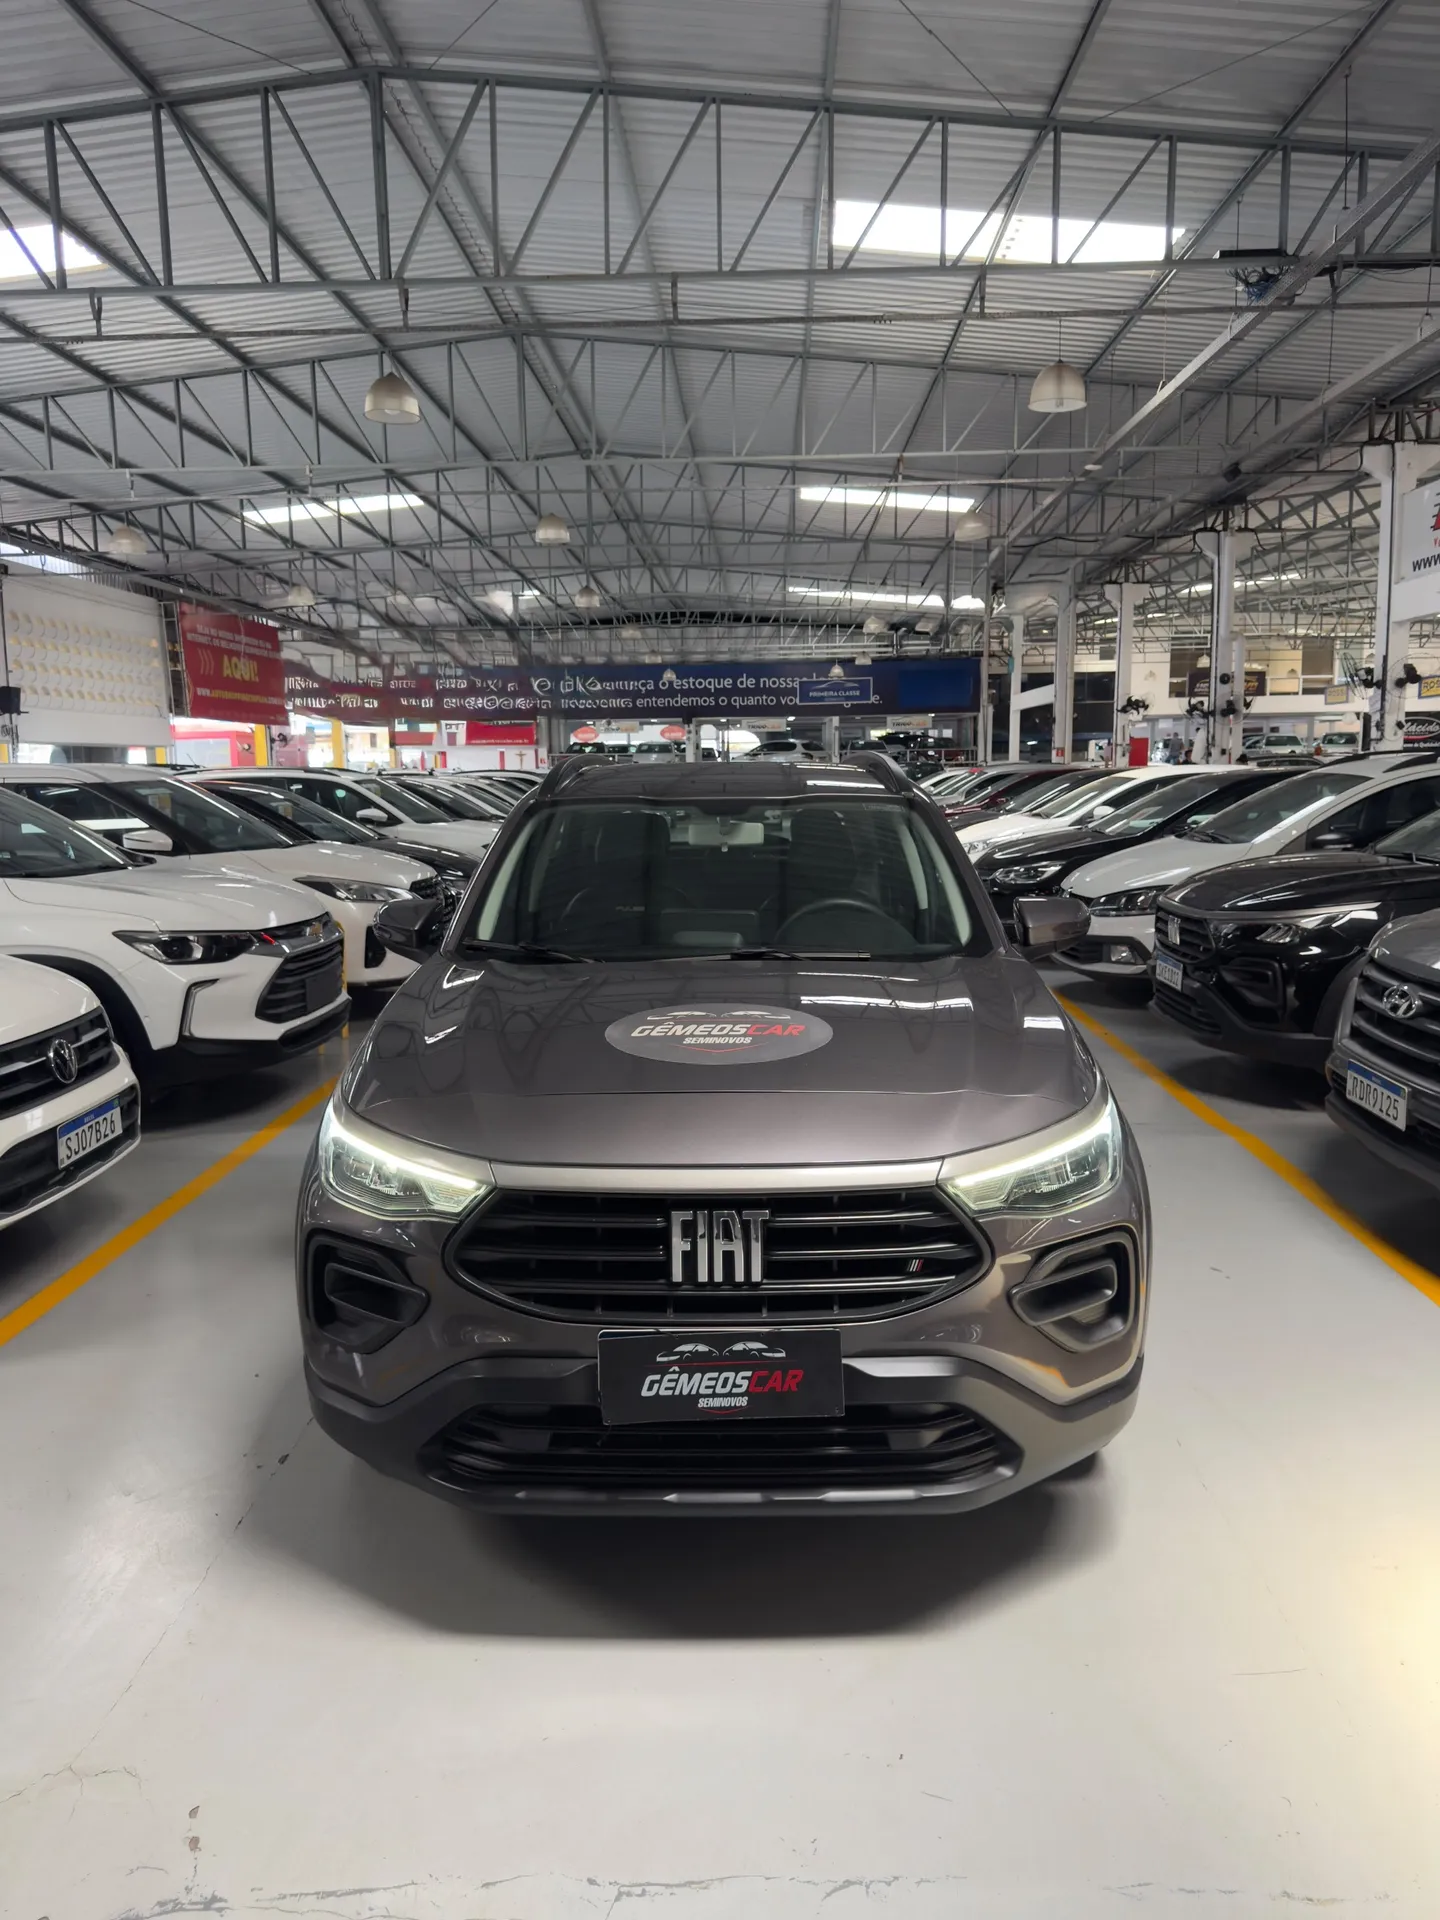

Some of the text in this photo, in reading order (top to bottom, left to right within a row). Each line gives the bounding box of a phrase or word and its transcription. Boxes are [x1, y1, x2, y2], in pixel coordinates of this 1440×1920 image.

[223, 654, 258, 682] AQUI!
[673, 677, 732, 694] estoque
[737, 673, 756, 688] de
[636, 693, 714, 707] entendemos
[718, 696, 727, 706] o
[731, 692, 776, 710] quanto
[630, 1021, 806, 1037] GÊMEOSCAR
[682, 1036, 752, 1045] SEMINOVOS
[670, 1210, 770, 1282] FIAT
[640, 1366, 804, 1397] GÊMEOSCAR
[698, 1396, 748, 1408] SEMINOVOS
